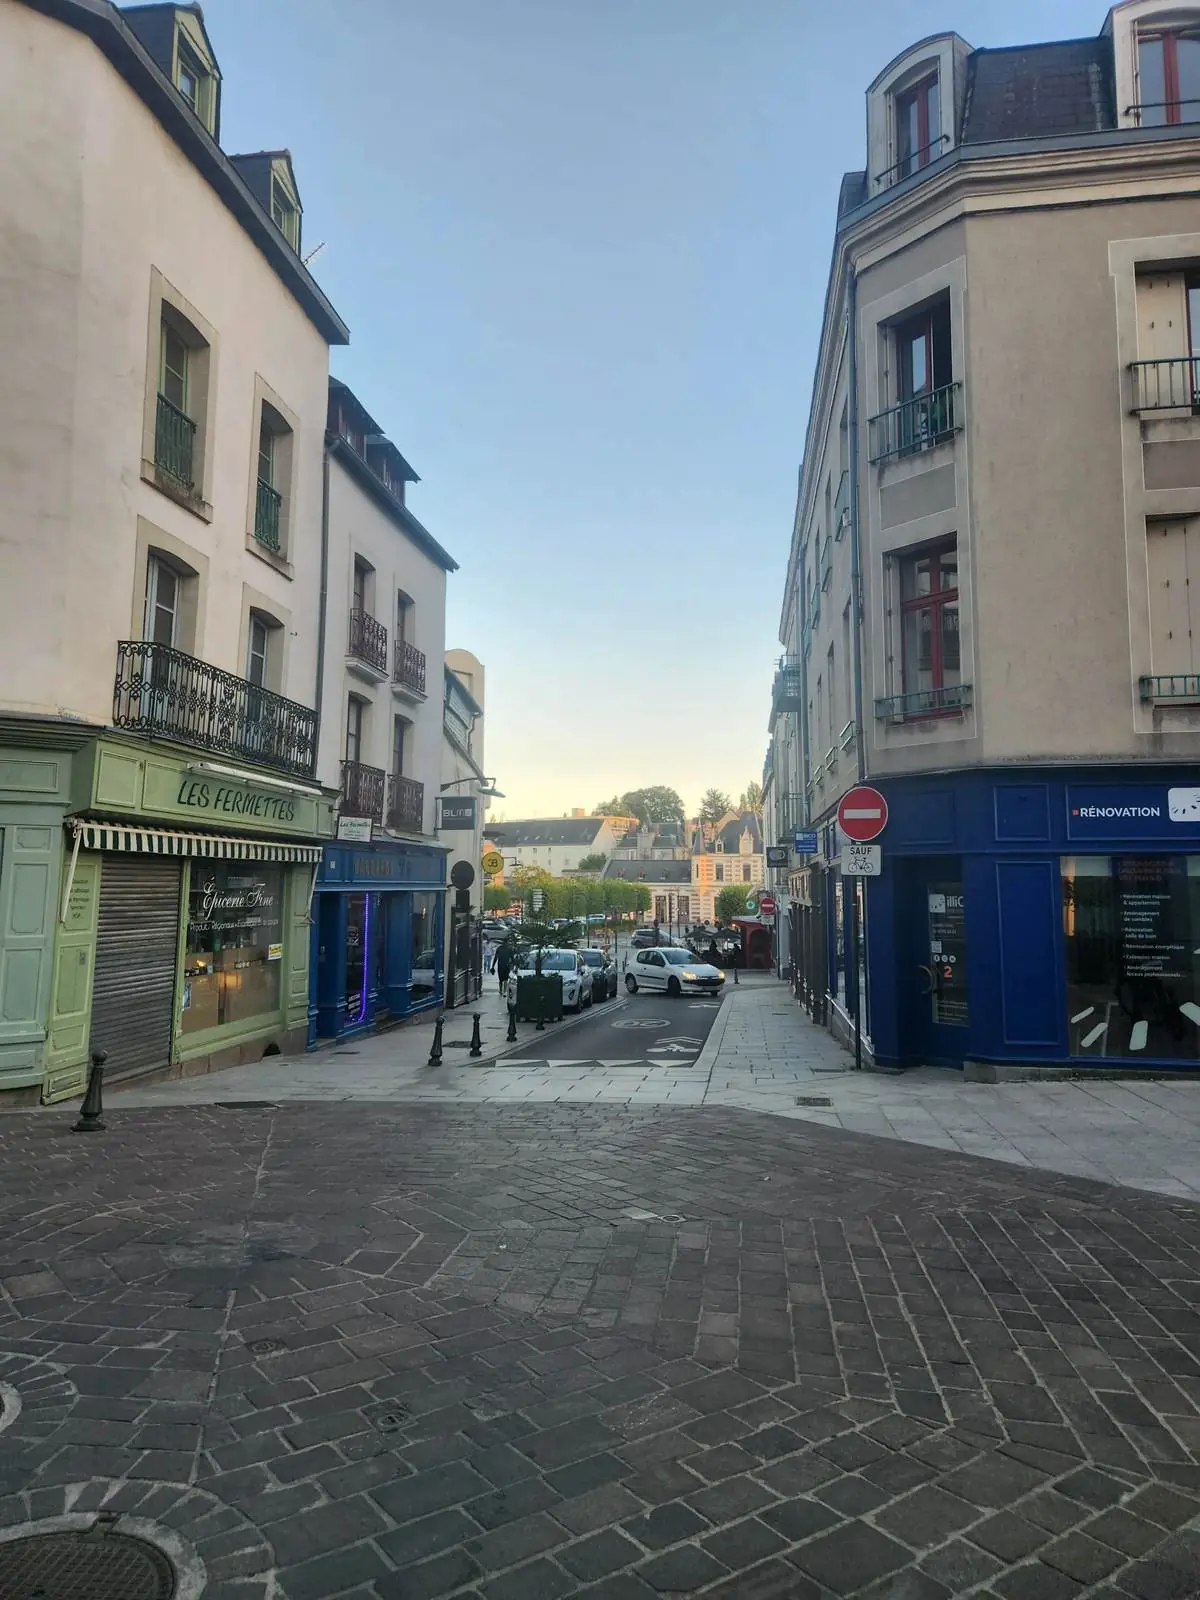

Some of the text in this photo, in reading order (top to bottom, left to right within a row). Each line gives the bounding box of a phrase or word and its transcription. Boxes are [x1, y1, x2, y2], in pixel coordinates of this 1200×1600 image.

[177, 779, 295, 822] LES FERMETTES
[1080, 805, 1161, 818] RÉNOVATION
[849, 847, 872, 855] SAUF
[203, 876, 274, 921] Épicerie Fine
[943, 966, 952, 979] 2
